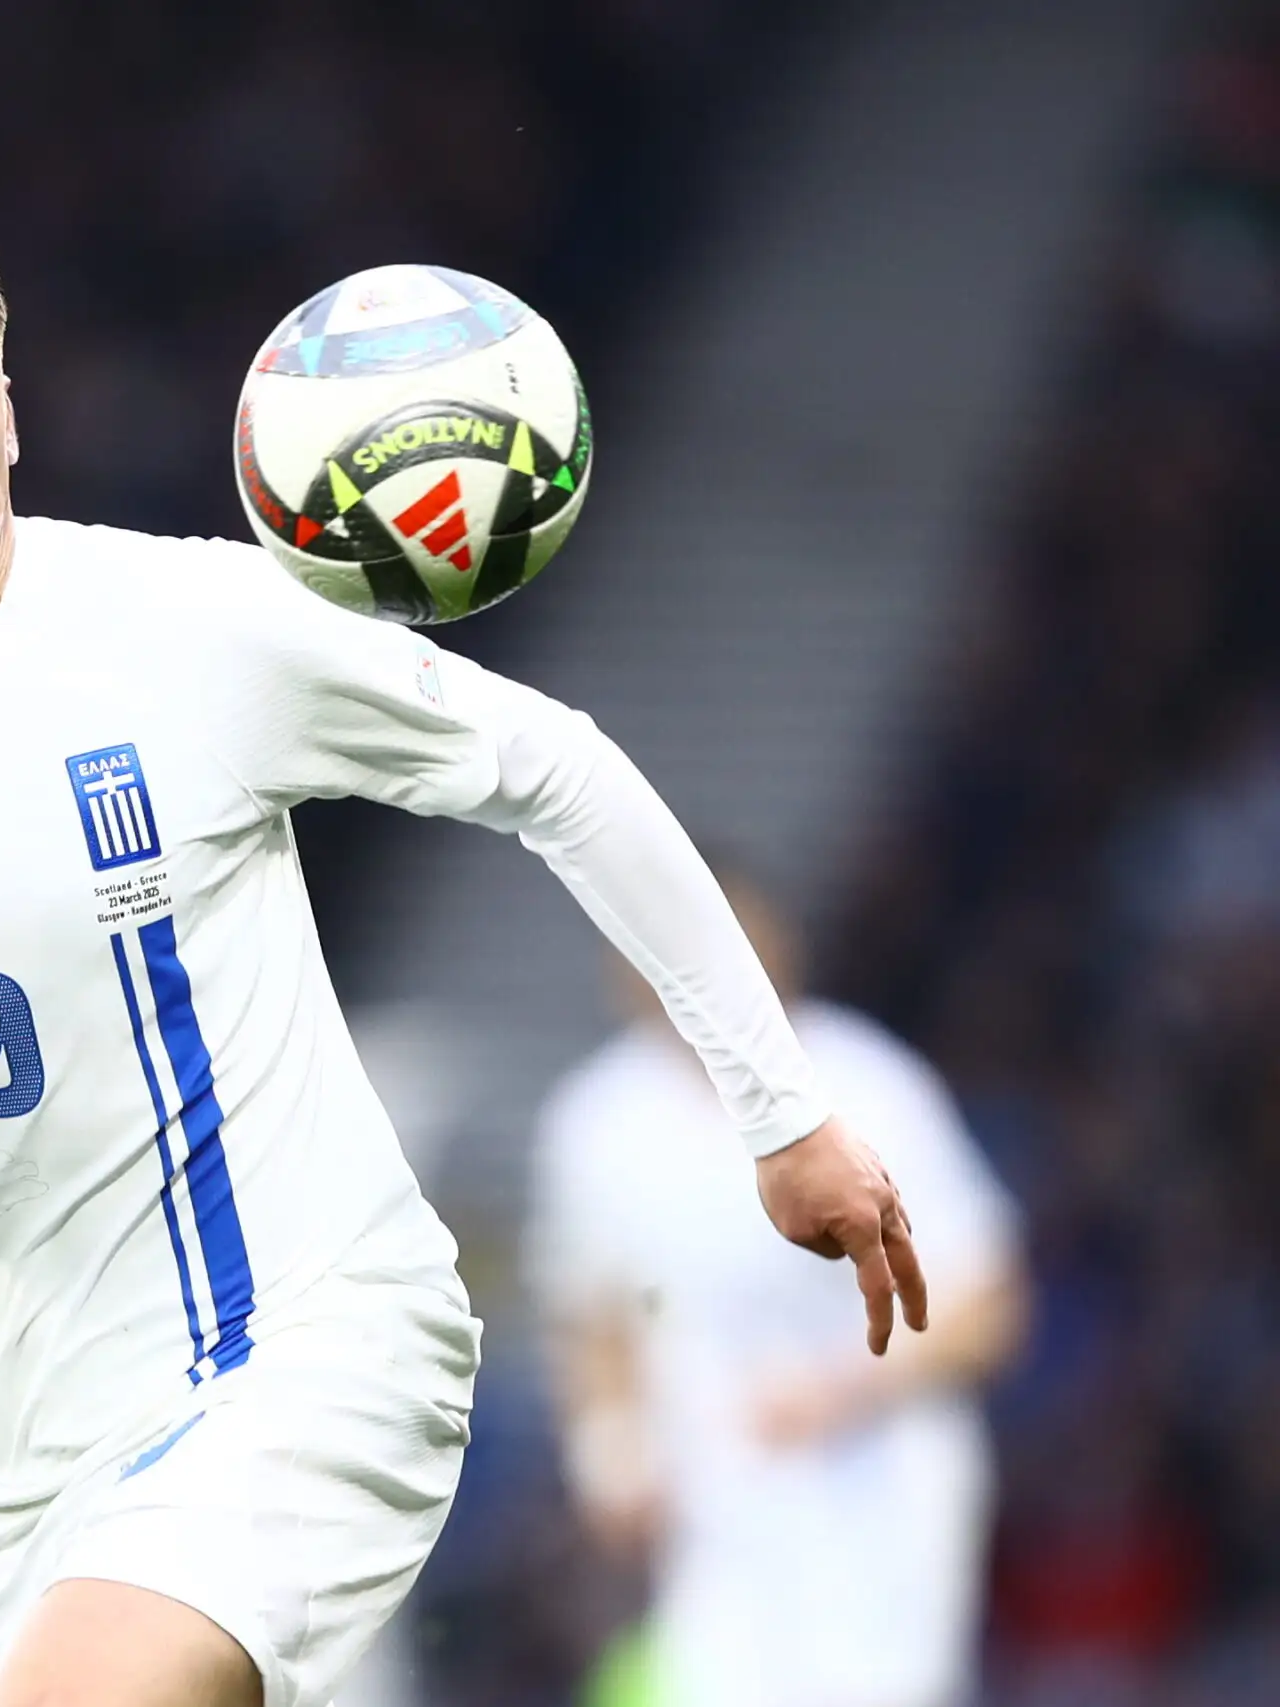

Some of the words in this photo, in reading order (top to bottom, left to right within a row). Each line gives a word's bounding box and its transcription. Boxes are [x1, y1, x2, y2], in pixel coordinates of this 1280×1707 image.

[353, 416, 495, 474] NATIONS
[94, 880, 132, 897] Scotland
[140, 872, 167, 886] Greece
[108, 897, 118, 908] 23
[119, 890, 142, 905] March
[143, 885, 160, 899] 2025
[97, 911, 125, 923] Glasgow
[131, 901, 158, 916] Hampden
[158, 895, 172, 907] Park
